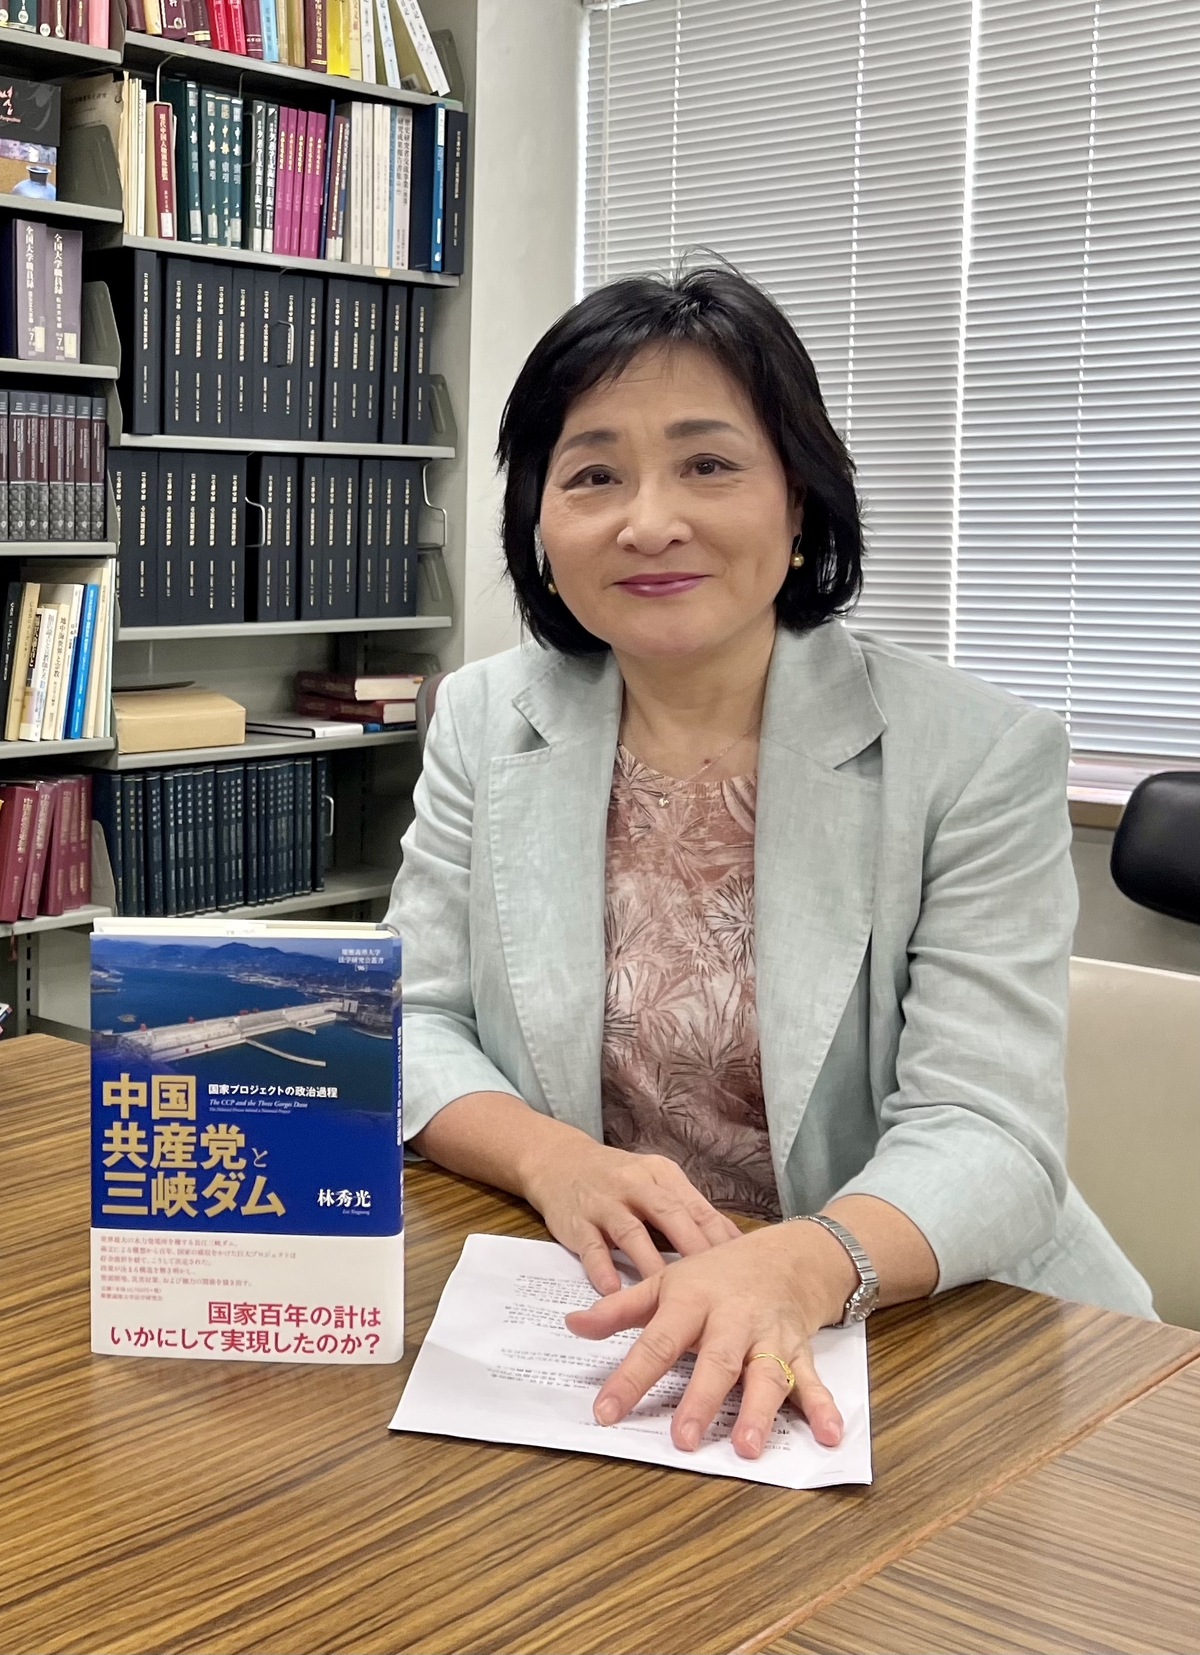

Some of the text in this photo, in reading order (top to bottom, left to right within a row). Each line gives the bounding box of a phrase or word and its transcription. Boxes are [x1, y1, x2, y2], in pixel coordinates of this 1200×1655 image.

[25, 225, 35, 289] 全国大学職員録
[53, 233, 63, 295] 全国大学職員録
[102, 1073, 198, 1121] 中国
[208, 1084, 340, 1099] 国家プロジェクトの政治過程
[102, 1121, 268, 1171] 共産党と
[102, 1171, 287, 1219] 三峡ダム
[317, 1189, 372, 1208] 林秀光
[208, 1301, 382, 1328] 国家百年の計は
[110, 1327, 382, 1355] いかにして実現したのか?
